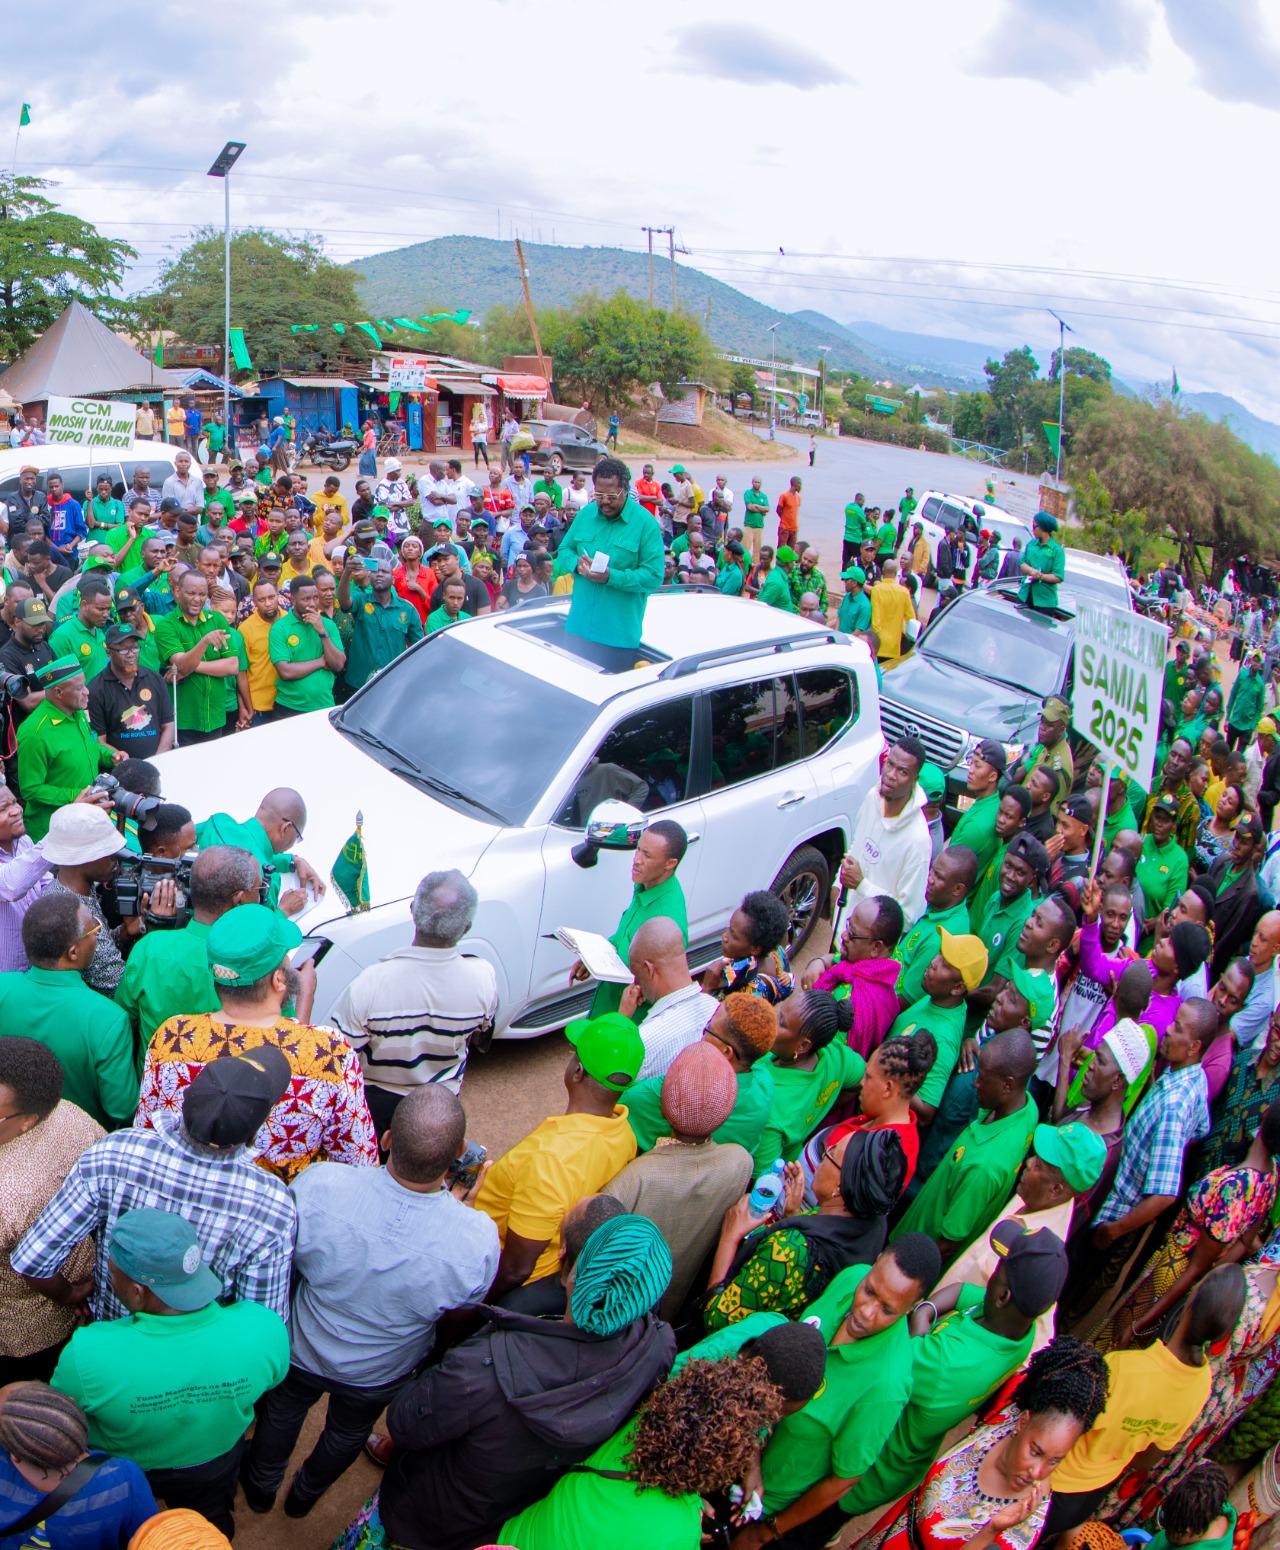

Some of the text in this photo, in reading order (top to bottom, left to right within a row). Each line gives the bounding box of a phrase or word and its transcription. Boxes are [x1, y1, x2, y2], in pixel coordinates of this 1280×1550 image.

[71, 401, 111, 416] CCM
[49, 414, 133, 434] MOSHI VIJIJINI
[49, 429, 130, 447] TUPO IMARA
[1080, 644, 1148, 725] SAMIA
[1090, 699, 1143, 771] 2025
